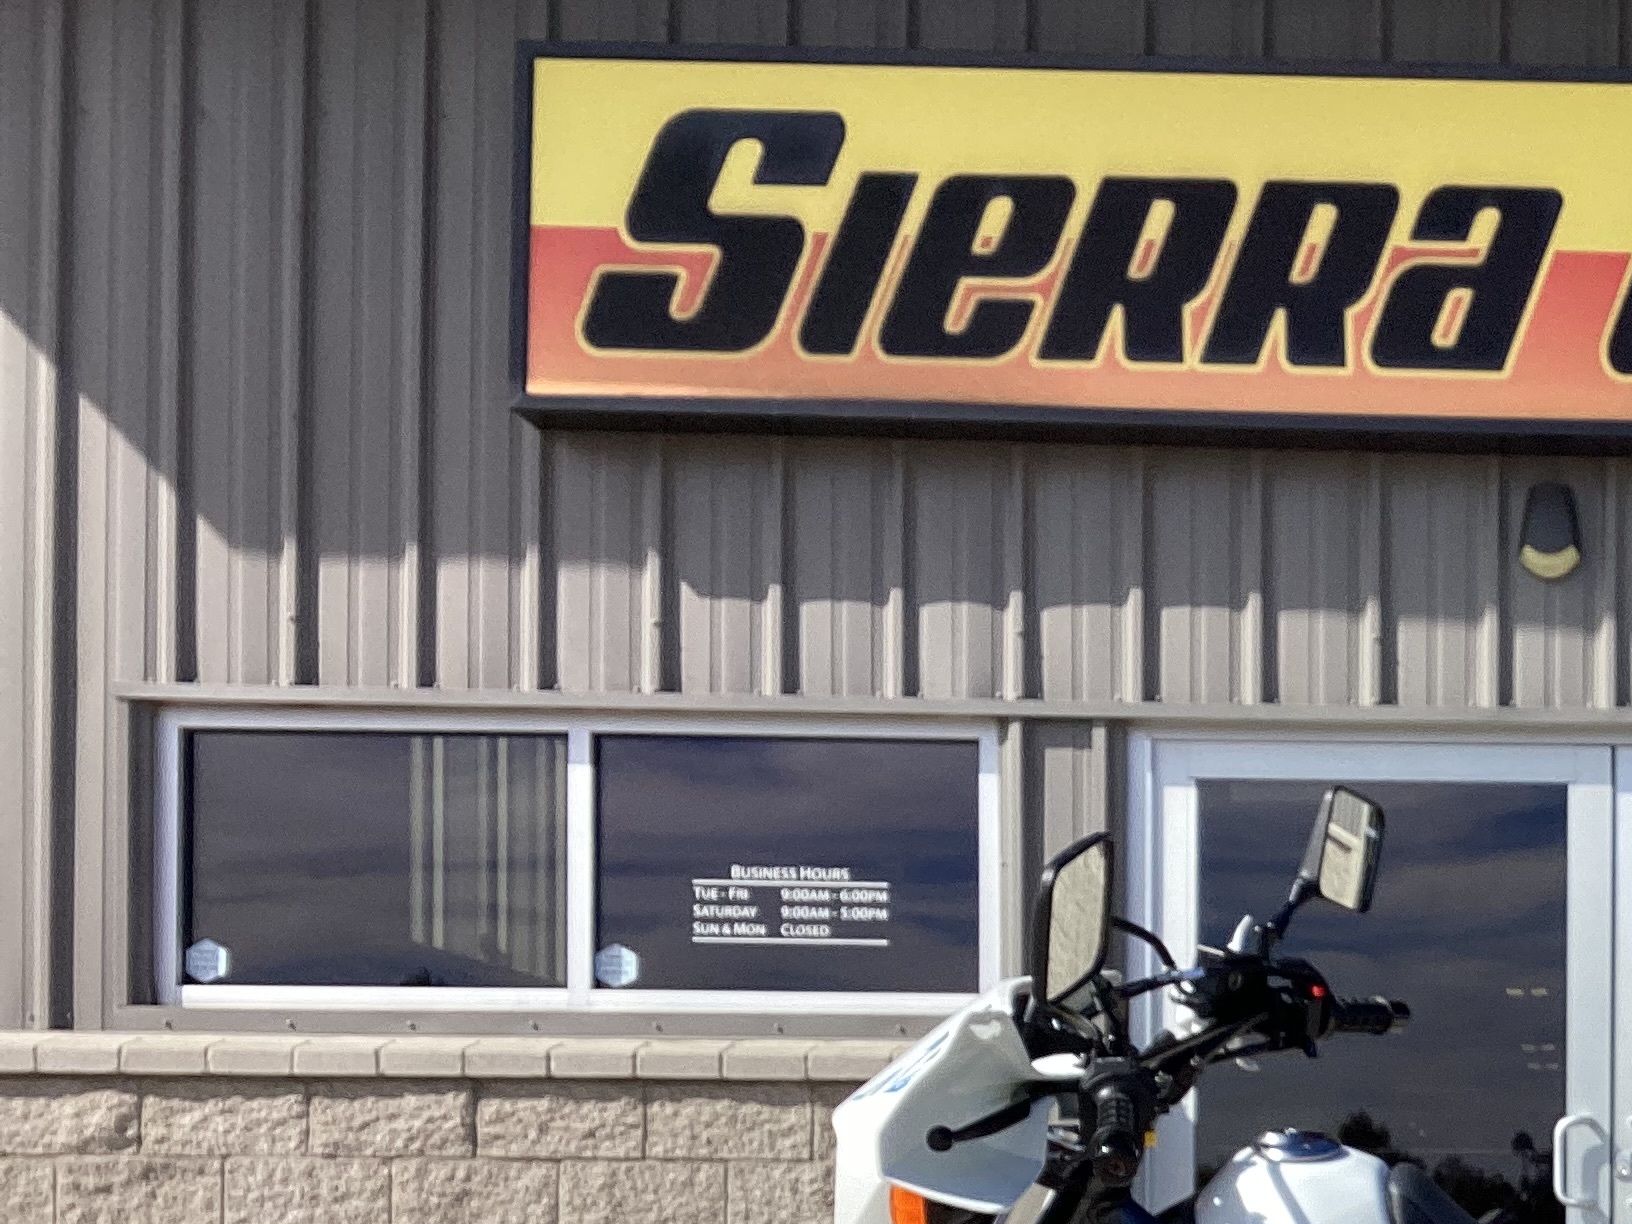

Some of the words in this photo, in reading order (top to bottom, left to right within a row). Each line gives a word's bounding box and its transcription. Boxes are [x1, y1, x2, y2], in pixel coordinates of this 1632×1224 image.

[731, 864, 798, 880] BUSINESS
[799, 866, 850, 881] HOURS
[693, 886, 719, 901] TUE
[728, 886, 749, 901] FRI
[780, 887, 830, 902] 9:00AM
[839, 889, 888, 903] 6:00PM
[693, 903, 759, 919] SATURDAY
[780, 904, 830, 920] 9:00AM
[839, 906, 889, 921] 5:00PM
[693, 920, 720, 937] SUN
[733, 922, 767, 937] MON
[780, 922, 831, 938] CLOSED
